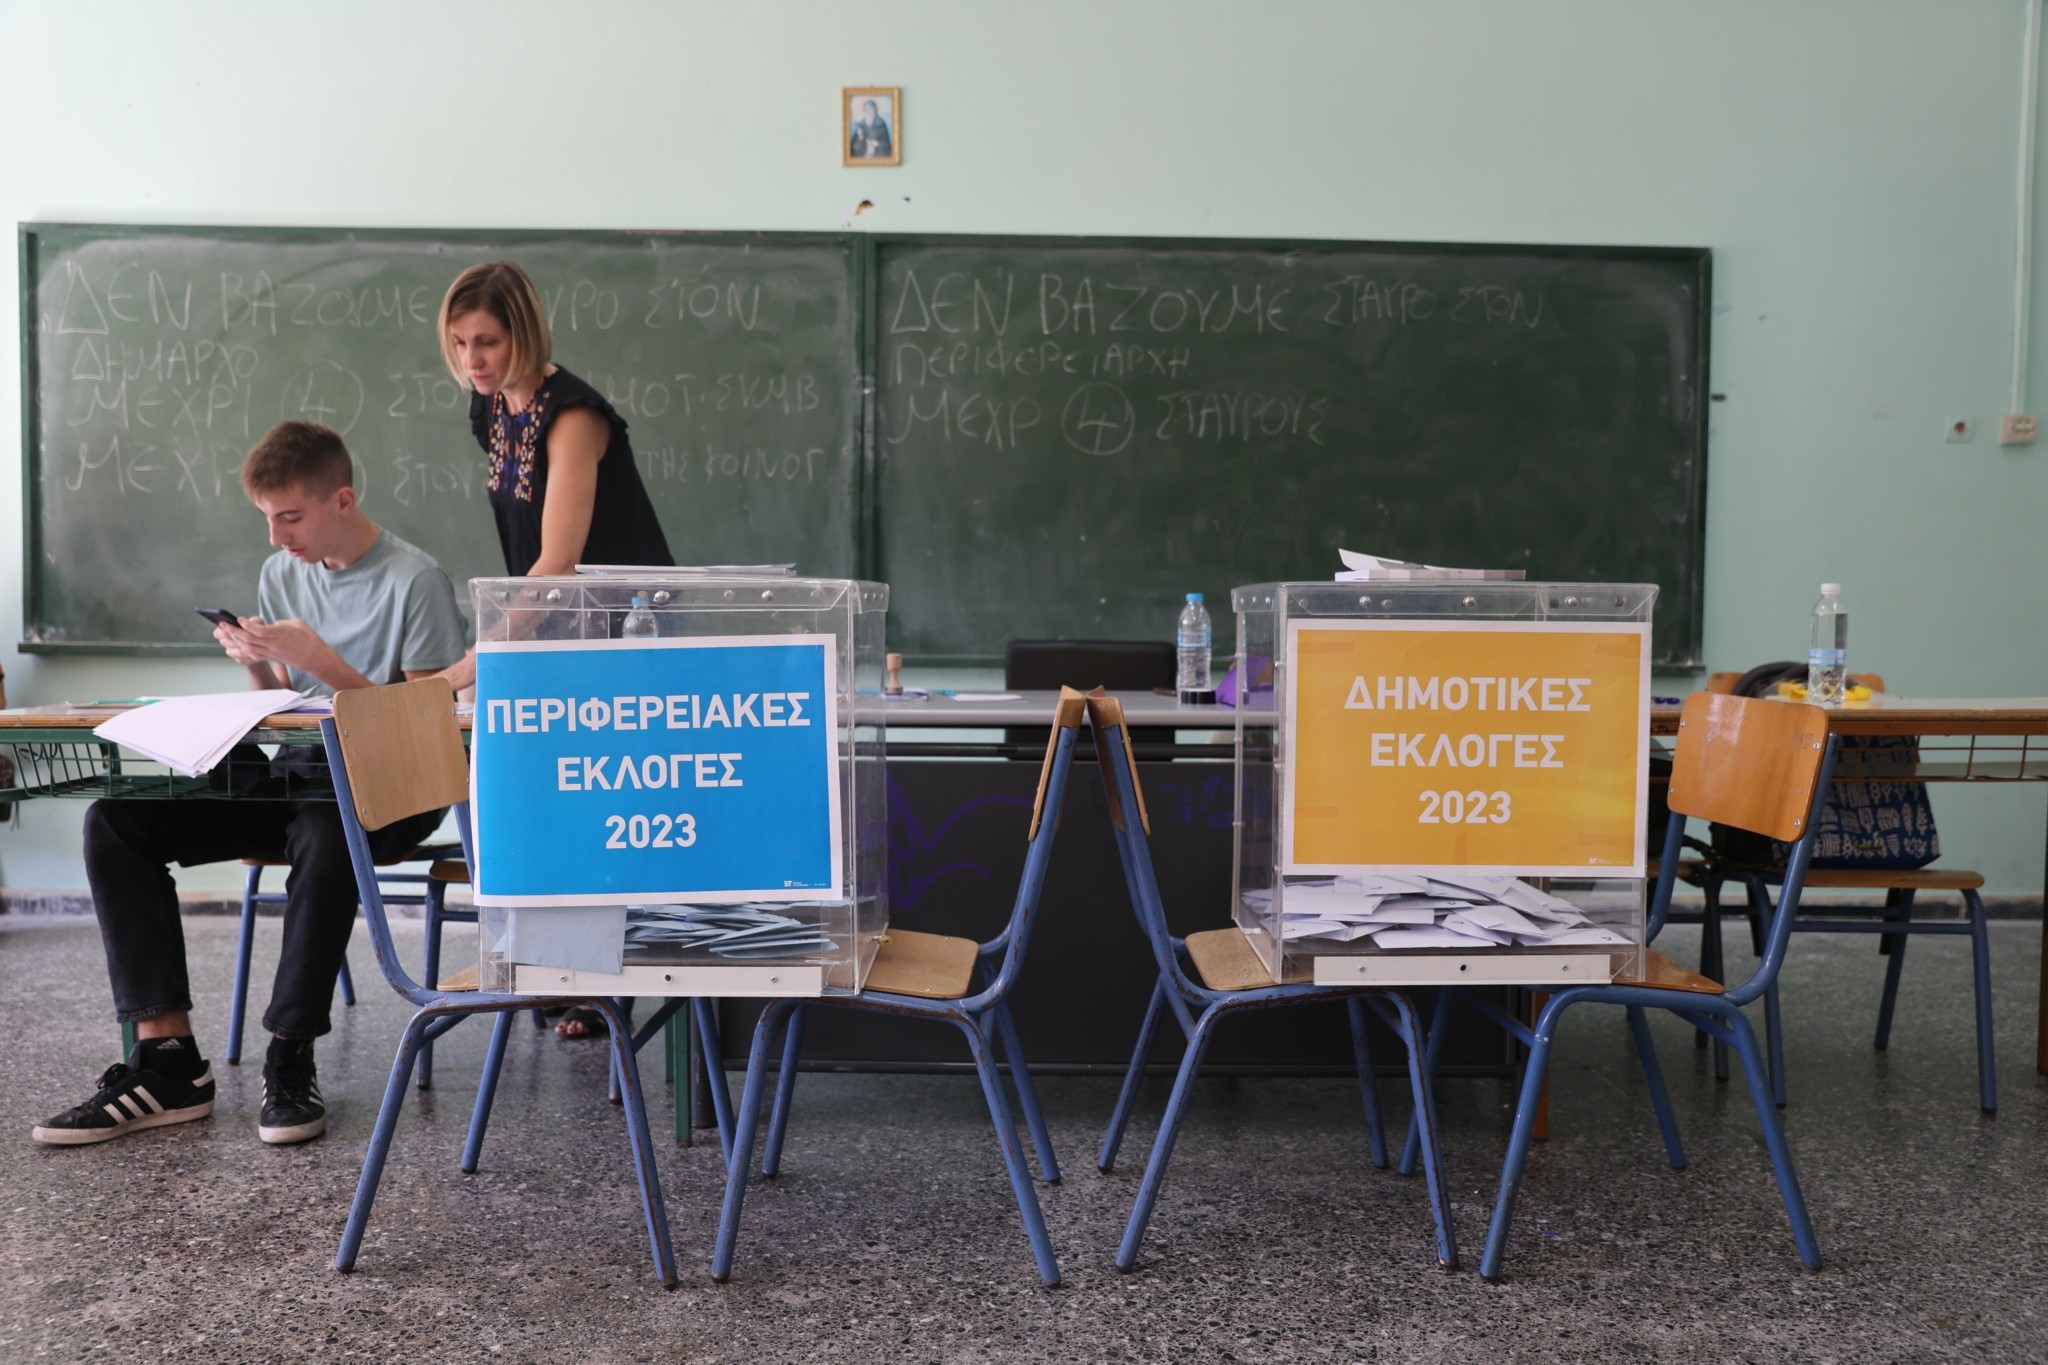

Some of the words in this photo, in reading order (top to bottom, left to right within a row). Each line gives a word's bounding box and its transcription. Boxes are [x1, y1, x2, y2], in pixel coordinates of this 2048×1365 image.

[890, 269, 1013, 335] ΔΕΝ
[1343, 675, 1592, 712] ΔΗΜΟΤΙΚΕΣ
[486, 692, 812, 734] ΠΕΡΙΦΕΡΕΙΑΚΕΣ
[1370, 733, 1565, 769] ΕΚΛΟΓΕΣ
[557, 752, 744, 792] ΕΚΛΟΓΕΣ
[1418, 790, 1512, 824] 2023
[605, 813, 698, 850] 2023
